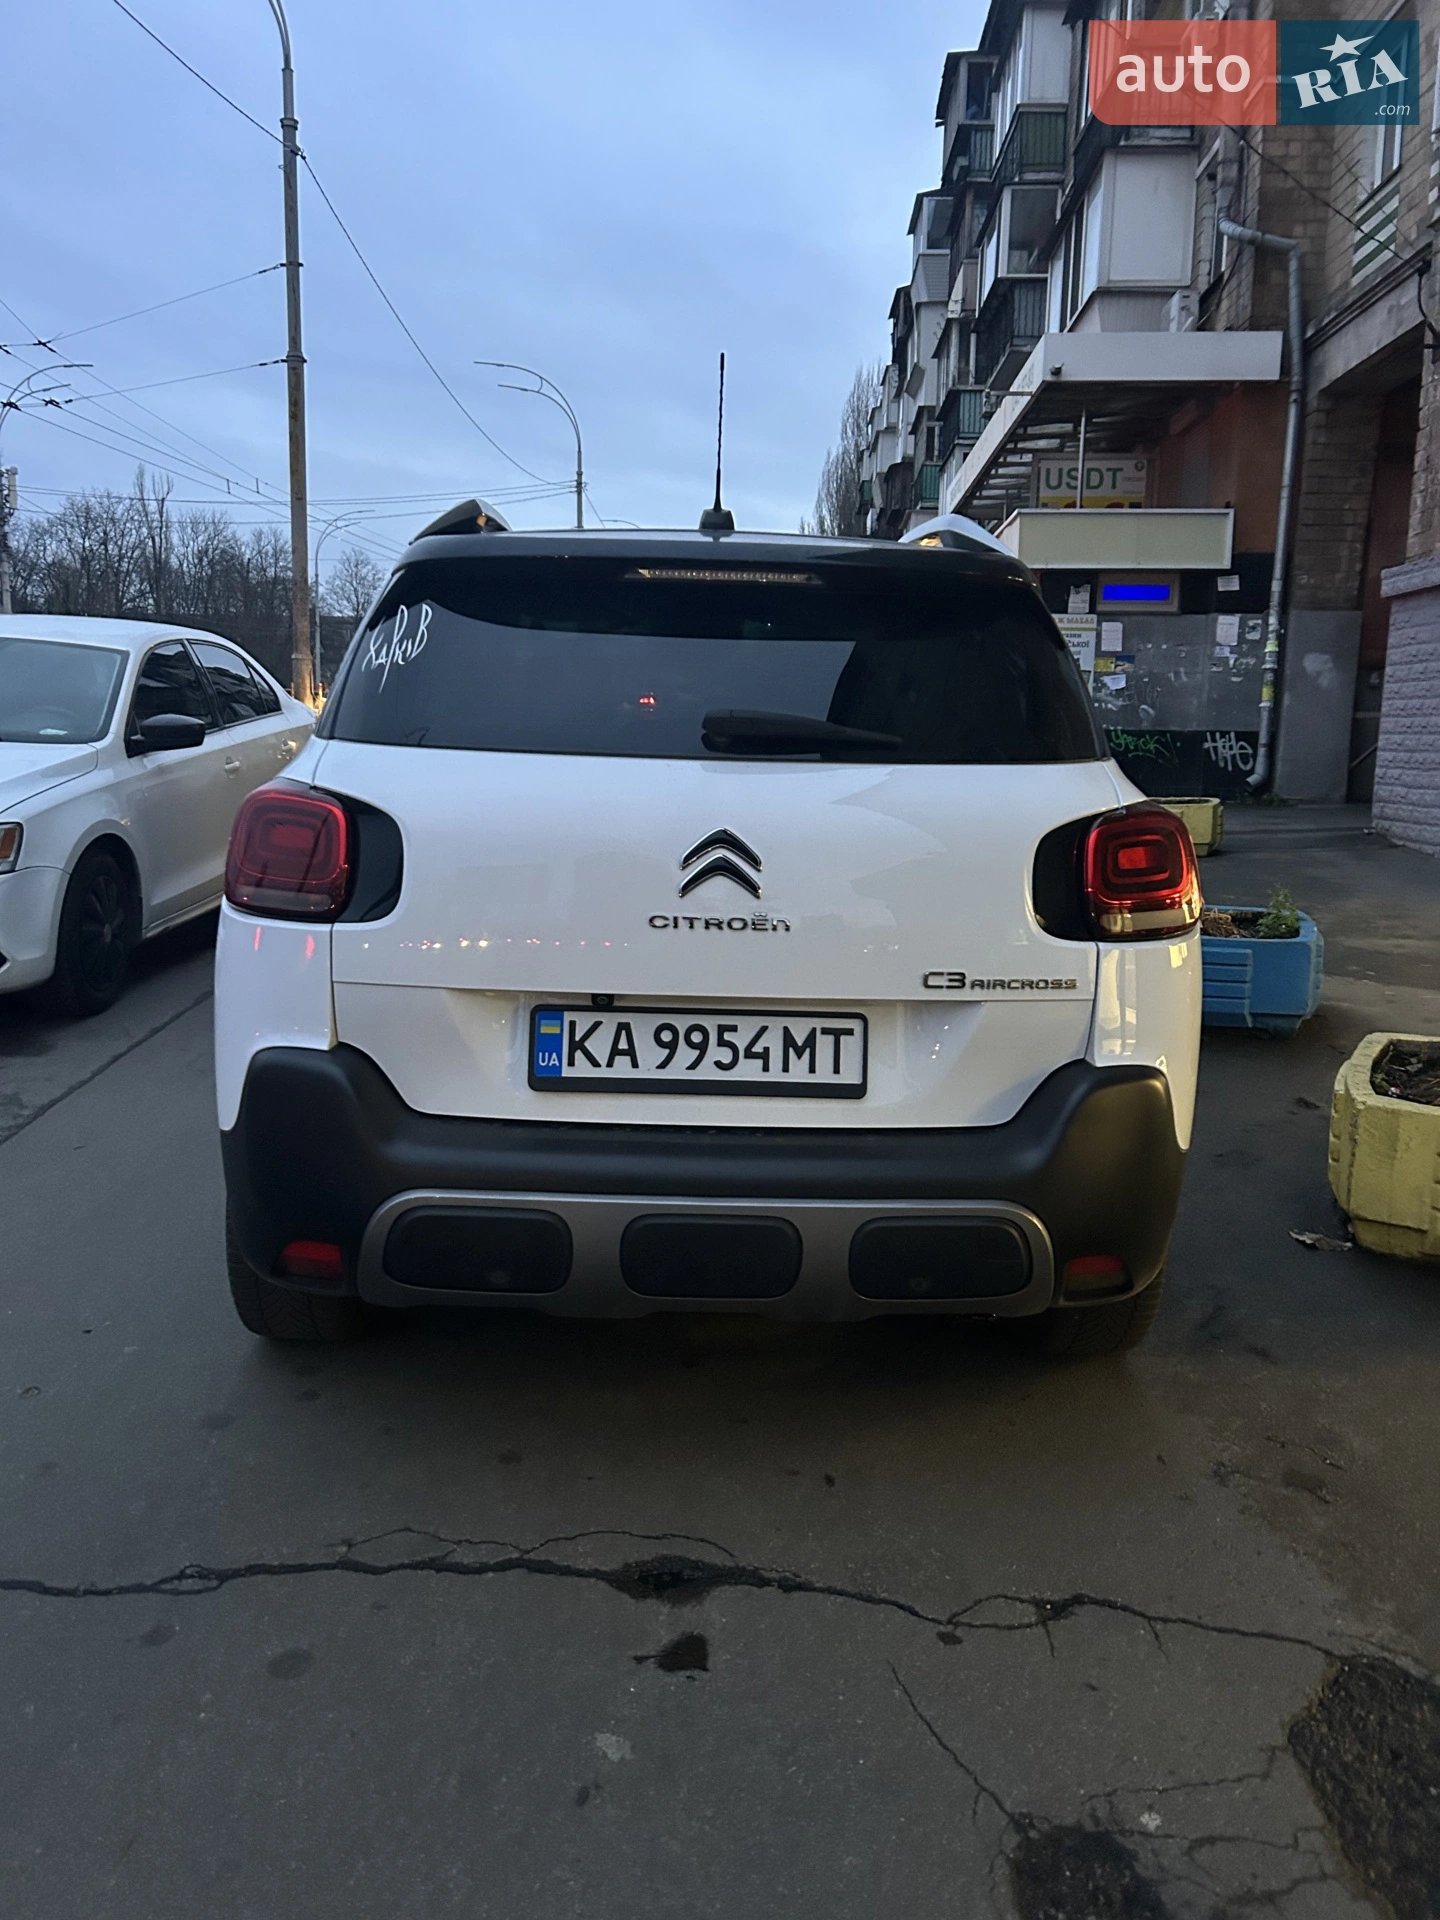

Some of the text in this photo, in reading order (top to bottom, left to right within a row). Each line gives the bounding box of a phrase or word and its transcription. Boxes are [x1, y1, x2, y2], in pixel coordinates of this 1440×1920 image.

[1045, 467, 1124, 491] USDT
[923, 972, 1079, 990] C3 AIRCROSS
[538, 1051, 560, 1067] UA
